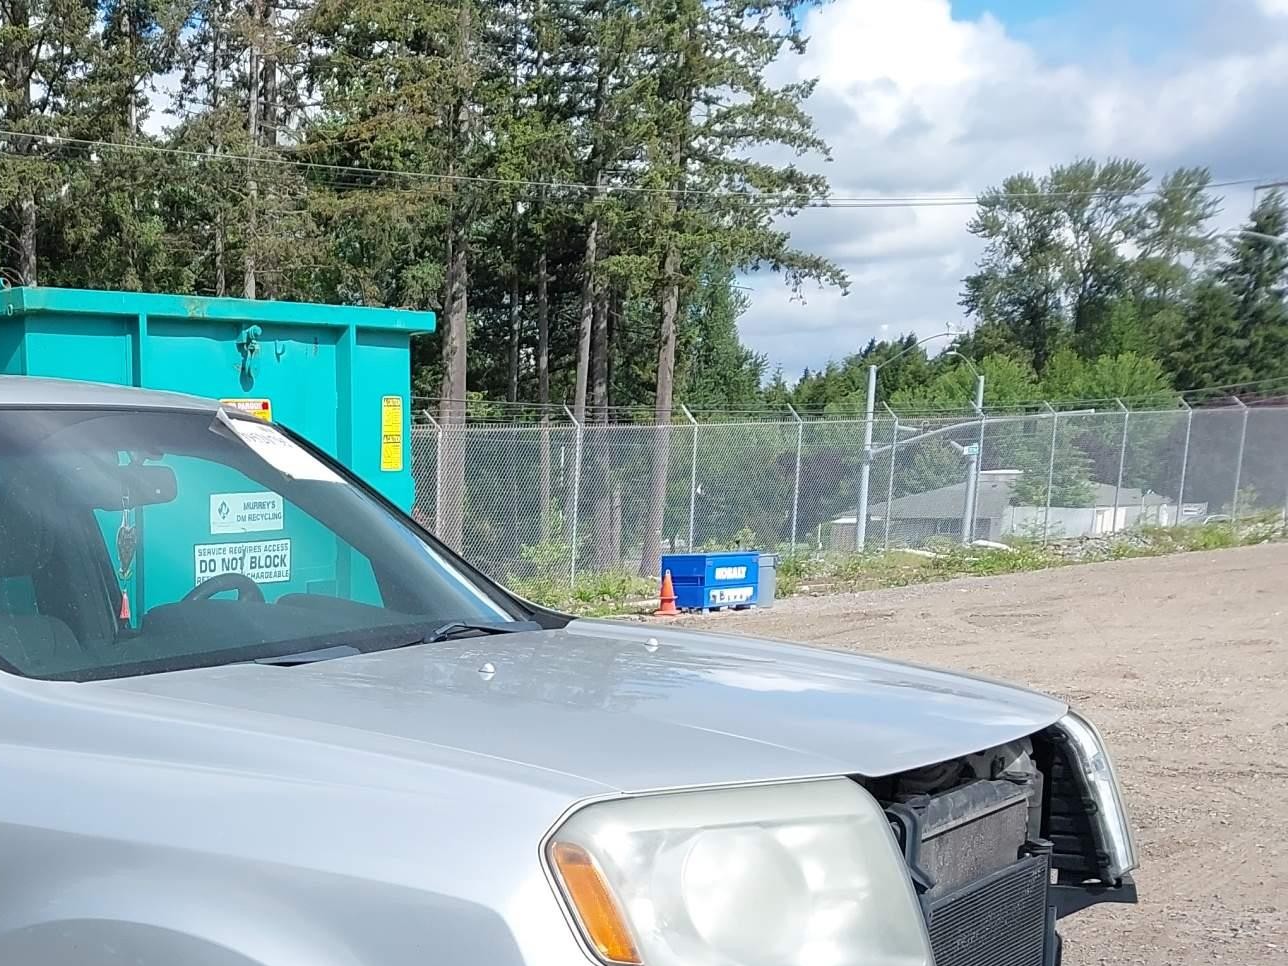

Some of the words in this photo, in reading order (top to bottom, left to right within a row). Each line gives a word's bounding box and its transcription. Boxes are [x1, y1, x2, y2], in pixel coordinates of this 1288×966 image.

[248, 512, 282, 521] RECYCLING
[198, 547, 227, 557] SERVICE
[264, 543, 289, 552] ACCESS
[200, 559, 216, 573] DO
[222, 556, 244, 571] NOT
[250, 554, 287, 569] BLOCK
